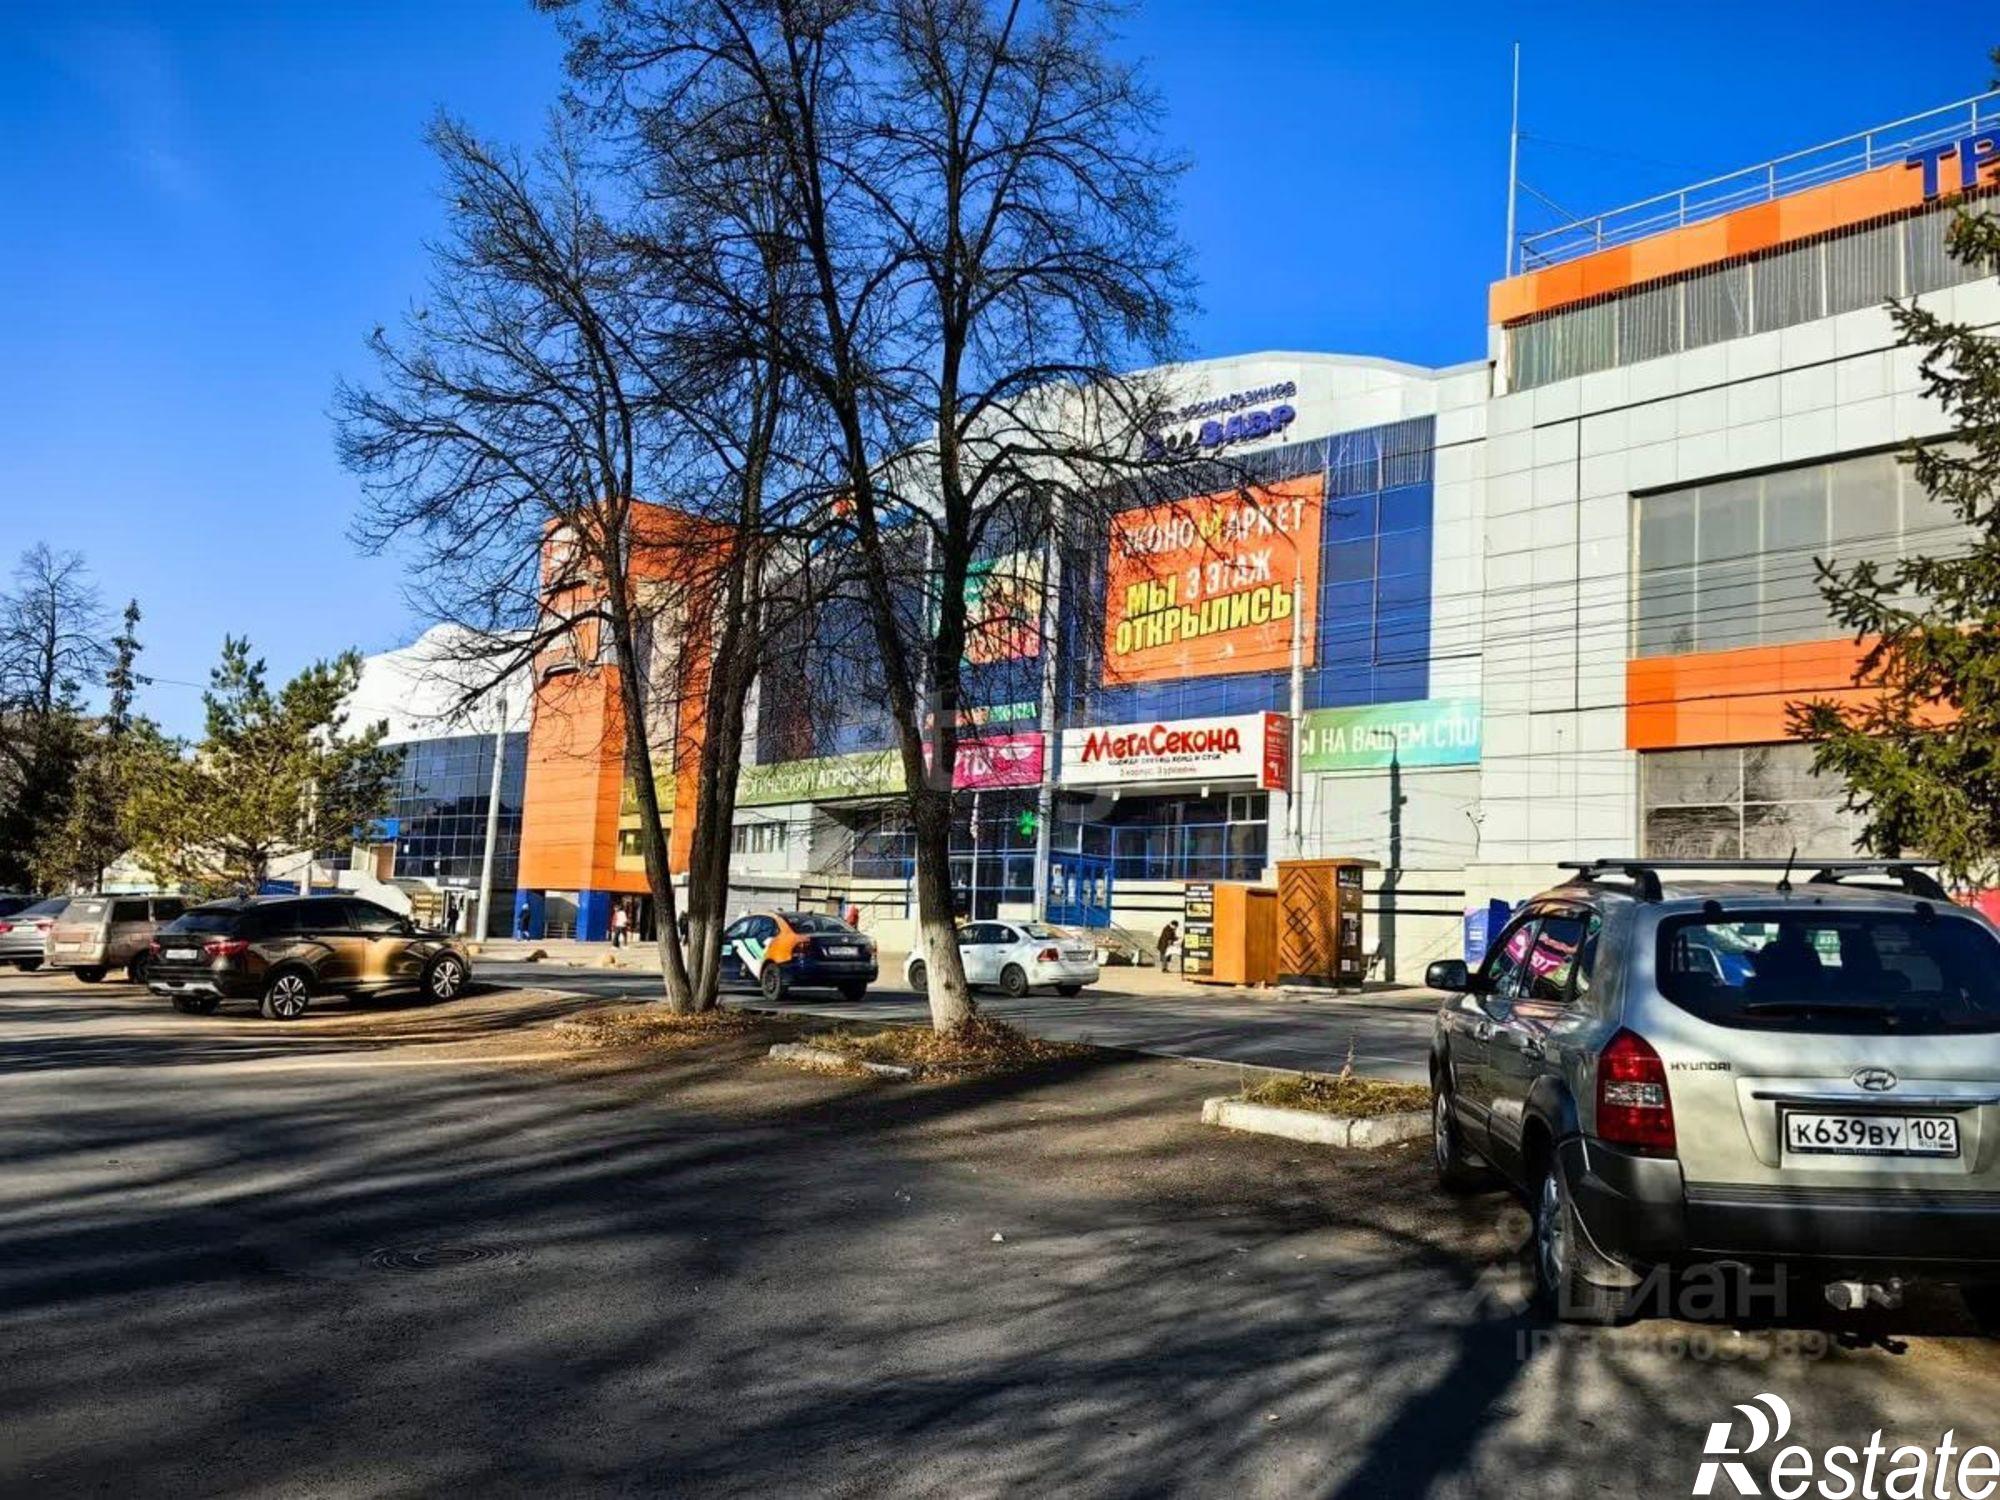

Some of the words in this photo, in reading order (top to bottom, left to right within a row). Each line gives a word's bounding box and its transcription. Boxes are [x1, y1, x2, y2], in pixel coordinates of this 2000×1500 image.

[1126, 574, 1178, 617] МЫ
[1114, 582, 1294, 656] ОТКРЫЛИСЬ
[1321, 726, 1346, 754] НА
[1352, 720, 1427, 751] ВАШЕМ
[1670, 1060, 1731, 1072] HYUNDAI
[1910, 1120, 1951, 1141] 102
